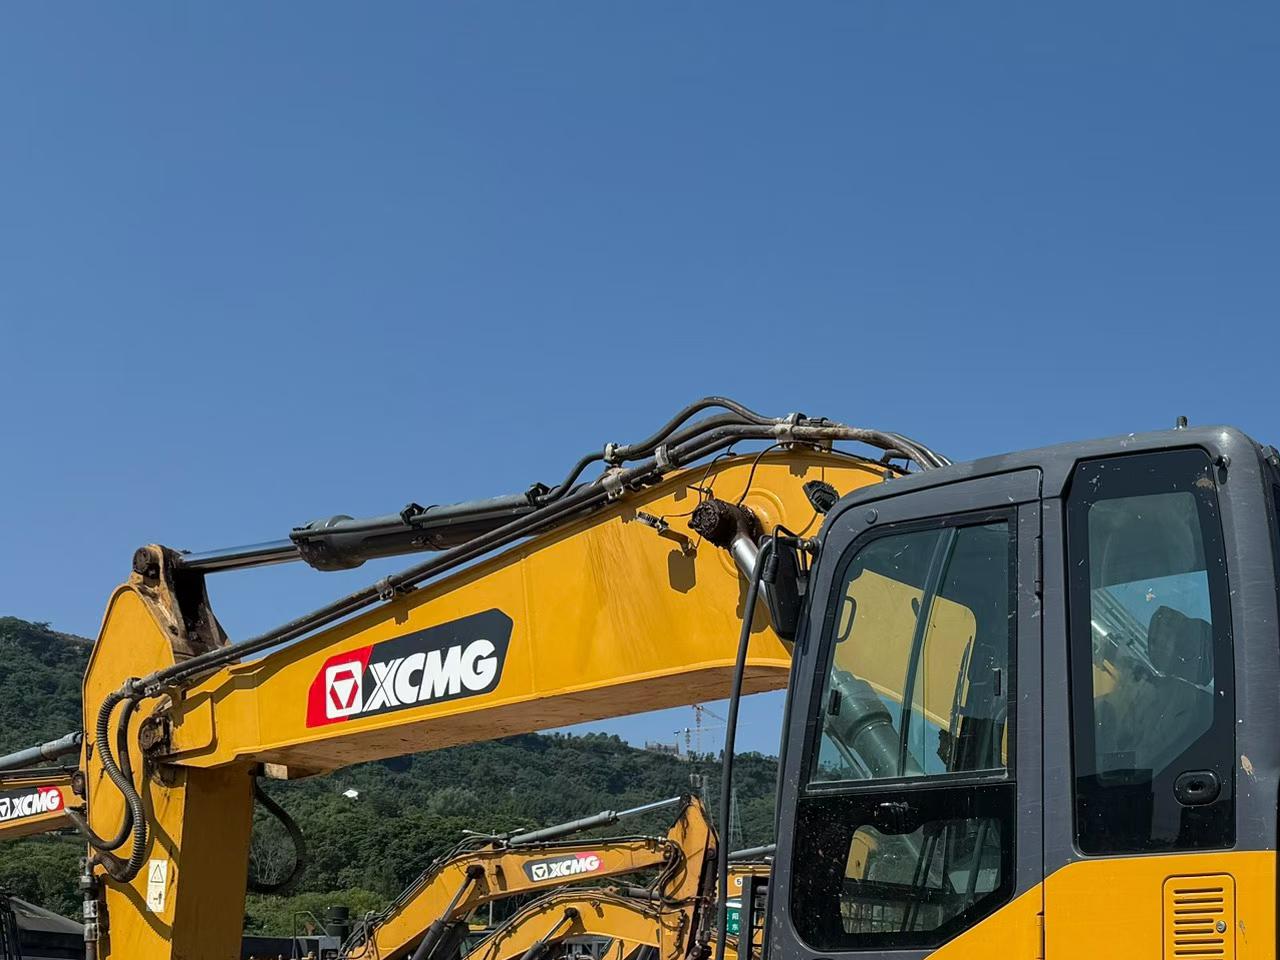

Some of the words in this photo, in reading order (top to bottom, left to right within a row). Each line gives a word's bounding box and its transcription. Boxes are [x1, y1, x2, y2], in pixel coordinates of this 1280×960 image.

[362, 639, 498, 712] XCMG
[11, 789, 60, 818] XCMG
[548, 855, 600, 877] XCMG
